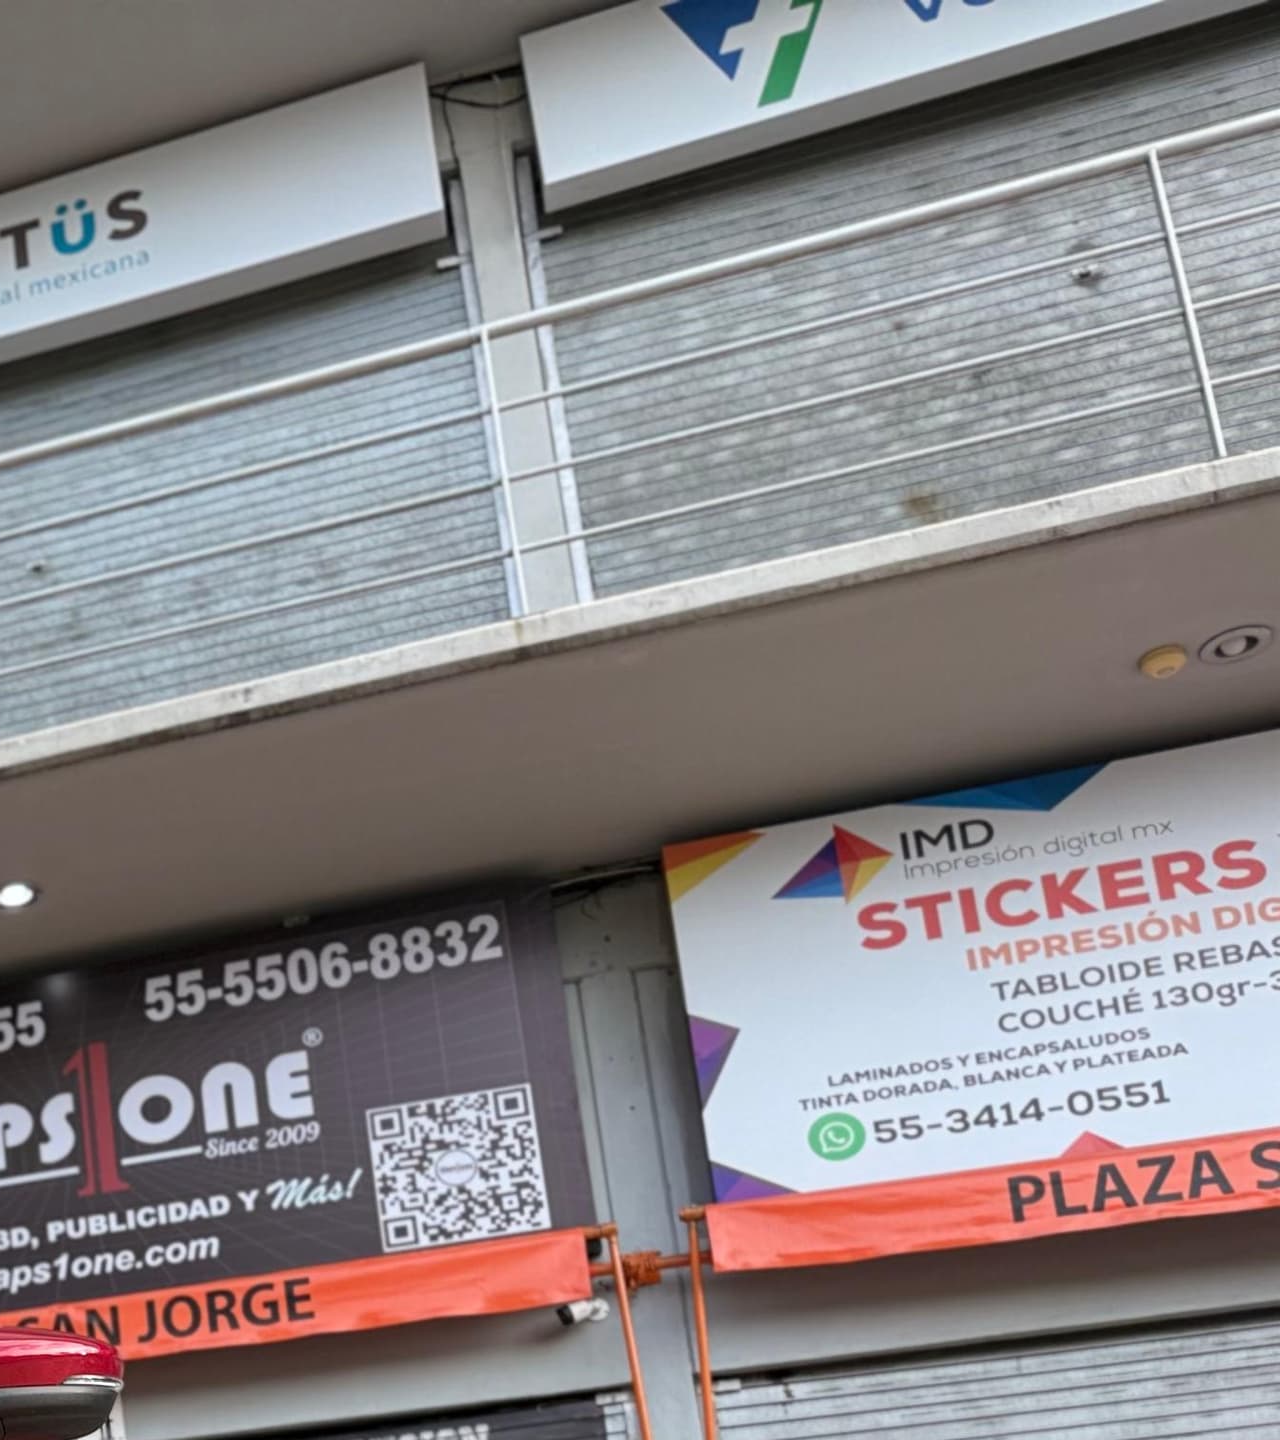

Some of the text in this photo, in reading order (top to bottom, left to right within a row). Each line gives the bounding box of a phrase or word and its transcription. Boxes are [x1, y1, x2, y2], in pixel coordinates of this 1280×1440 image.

[29, 248, 151, 298] mexicana
[900, 819, 994, 860] IMD
[904, 819, 1173, 880] Impresión digital mx
[857, 839, 1267, 951] STICKERS
[143, 915, 503, 1023] 55-5506-8832
[966, 909, 1201, 971] IMPRESIÓN
[991, 956, 1165, 1002] TABLOIDE
[997, 988, 1144, 1034] COUCHÉ
[799, 1042, 1188, 1112] TINTA DORADA, BLANCA Y PLATEADA
[828, 1027, 1151, 1087] LAMINADOS Y ENCAPSALUDOS
[205, 1121, 320, 1159] Since 2009
[873, 1080, 1171, 1144] 55-3414-0551
[46, 1196, 230, 1243] PUBLICIDAD
[237, 1189, 260, 1212] Y
[266, 1168, 363, 1210] Más!
[1008, 1150, 1234, 1222] PLAZA
[138, 1277, 316, 1343] JORGE
